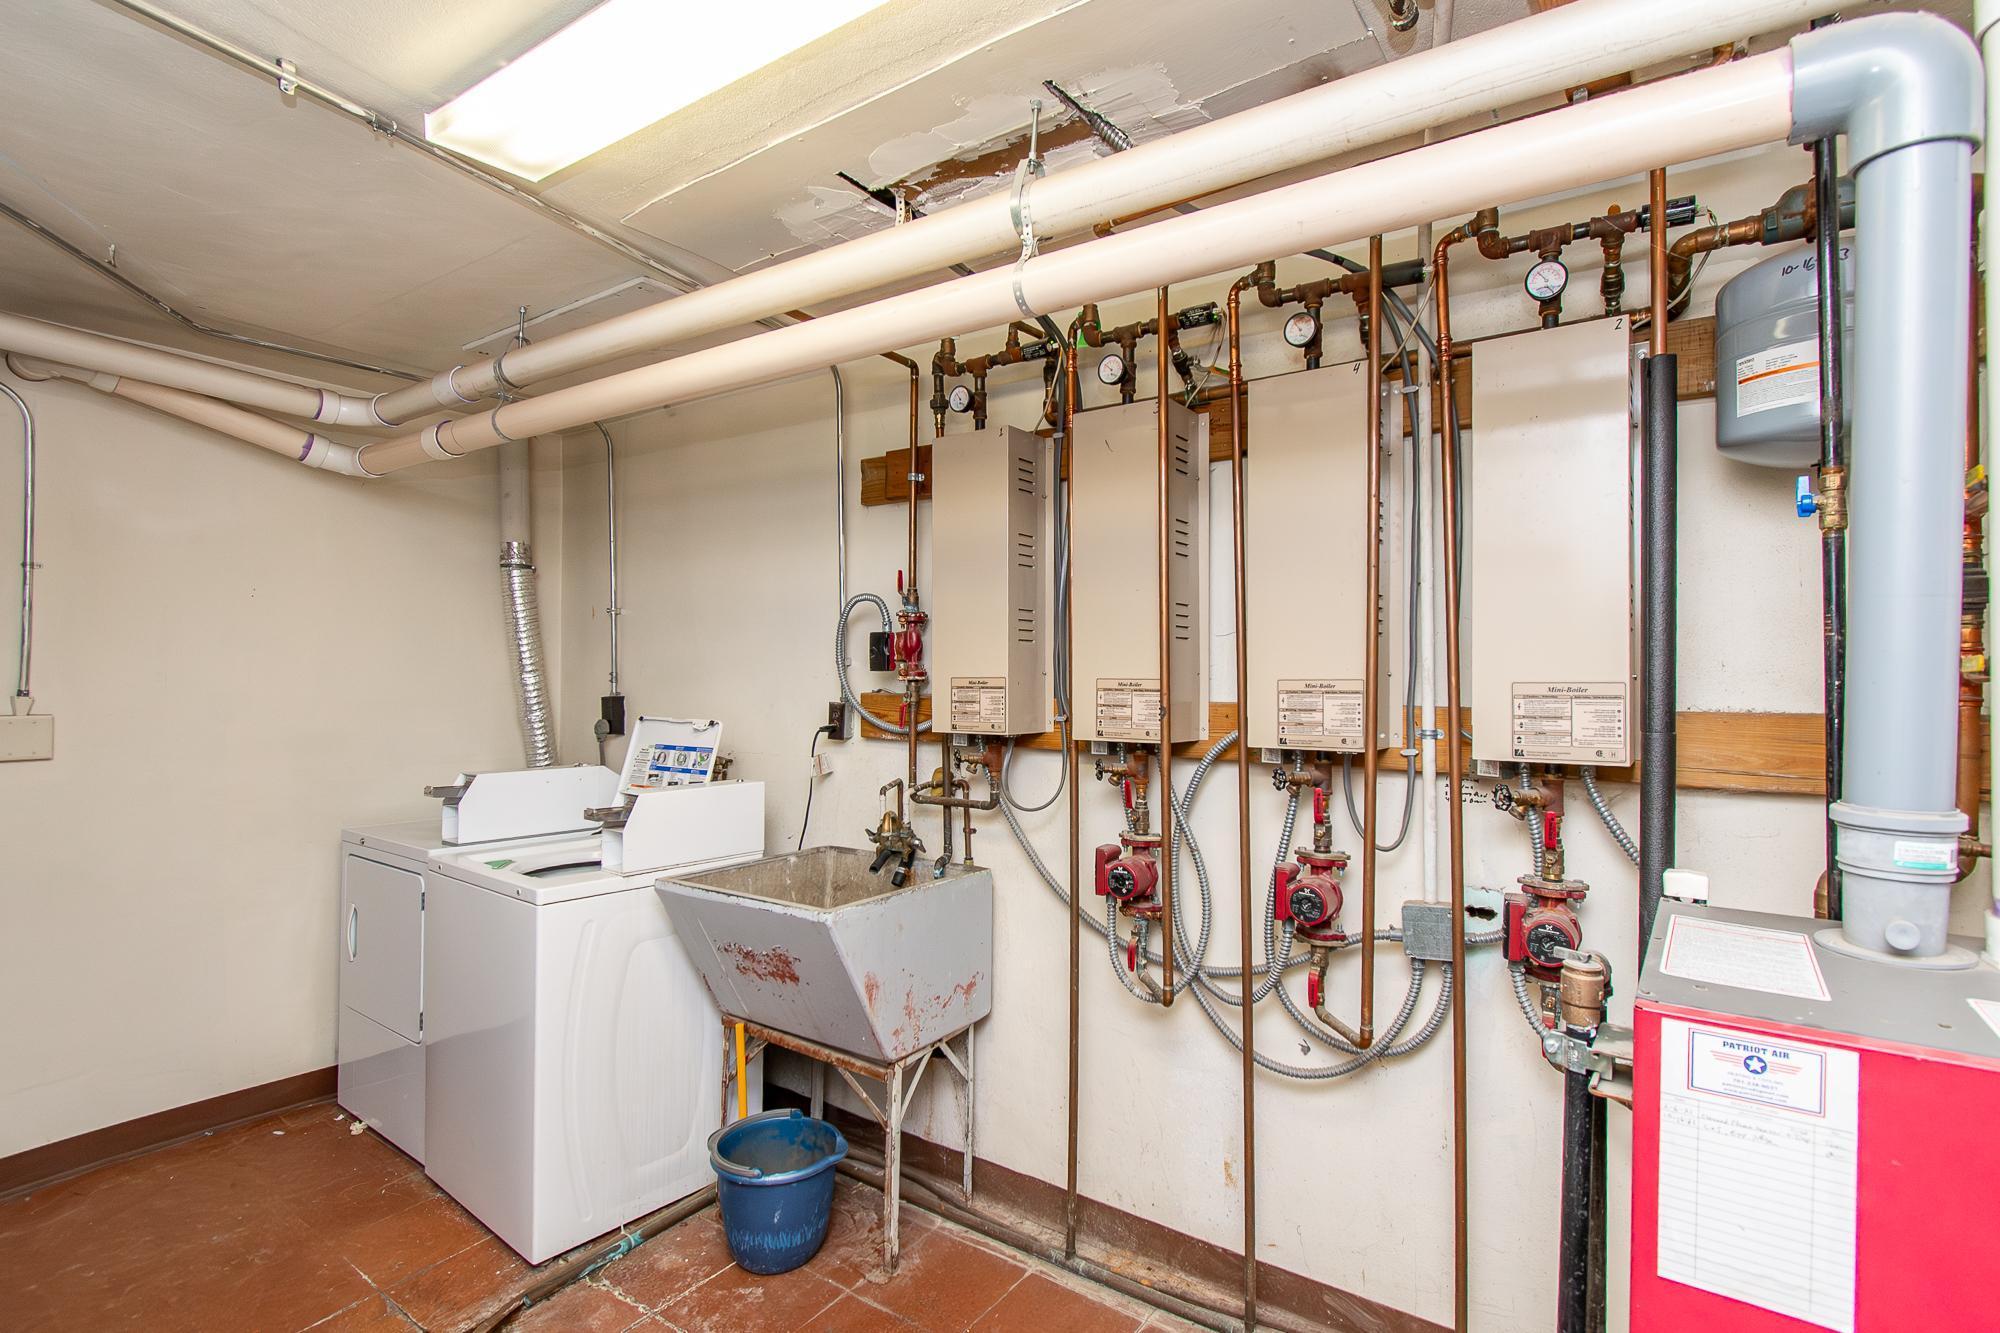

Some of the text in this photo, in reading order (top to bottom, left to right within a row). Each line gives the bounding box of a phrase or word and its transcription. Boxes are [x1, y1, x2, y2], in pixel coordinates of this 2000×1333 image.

[1614, 318, 1623, 331] 2
[1353, 362, 1361, 375] 4
[1722, 1040, 1790, 1060] PATRIOT AIR
